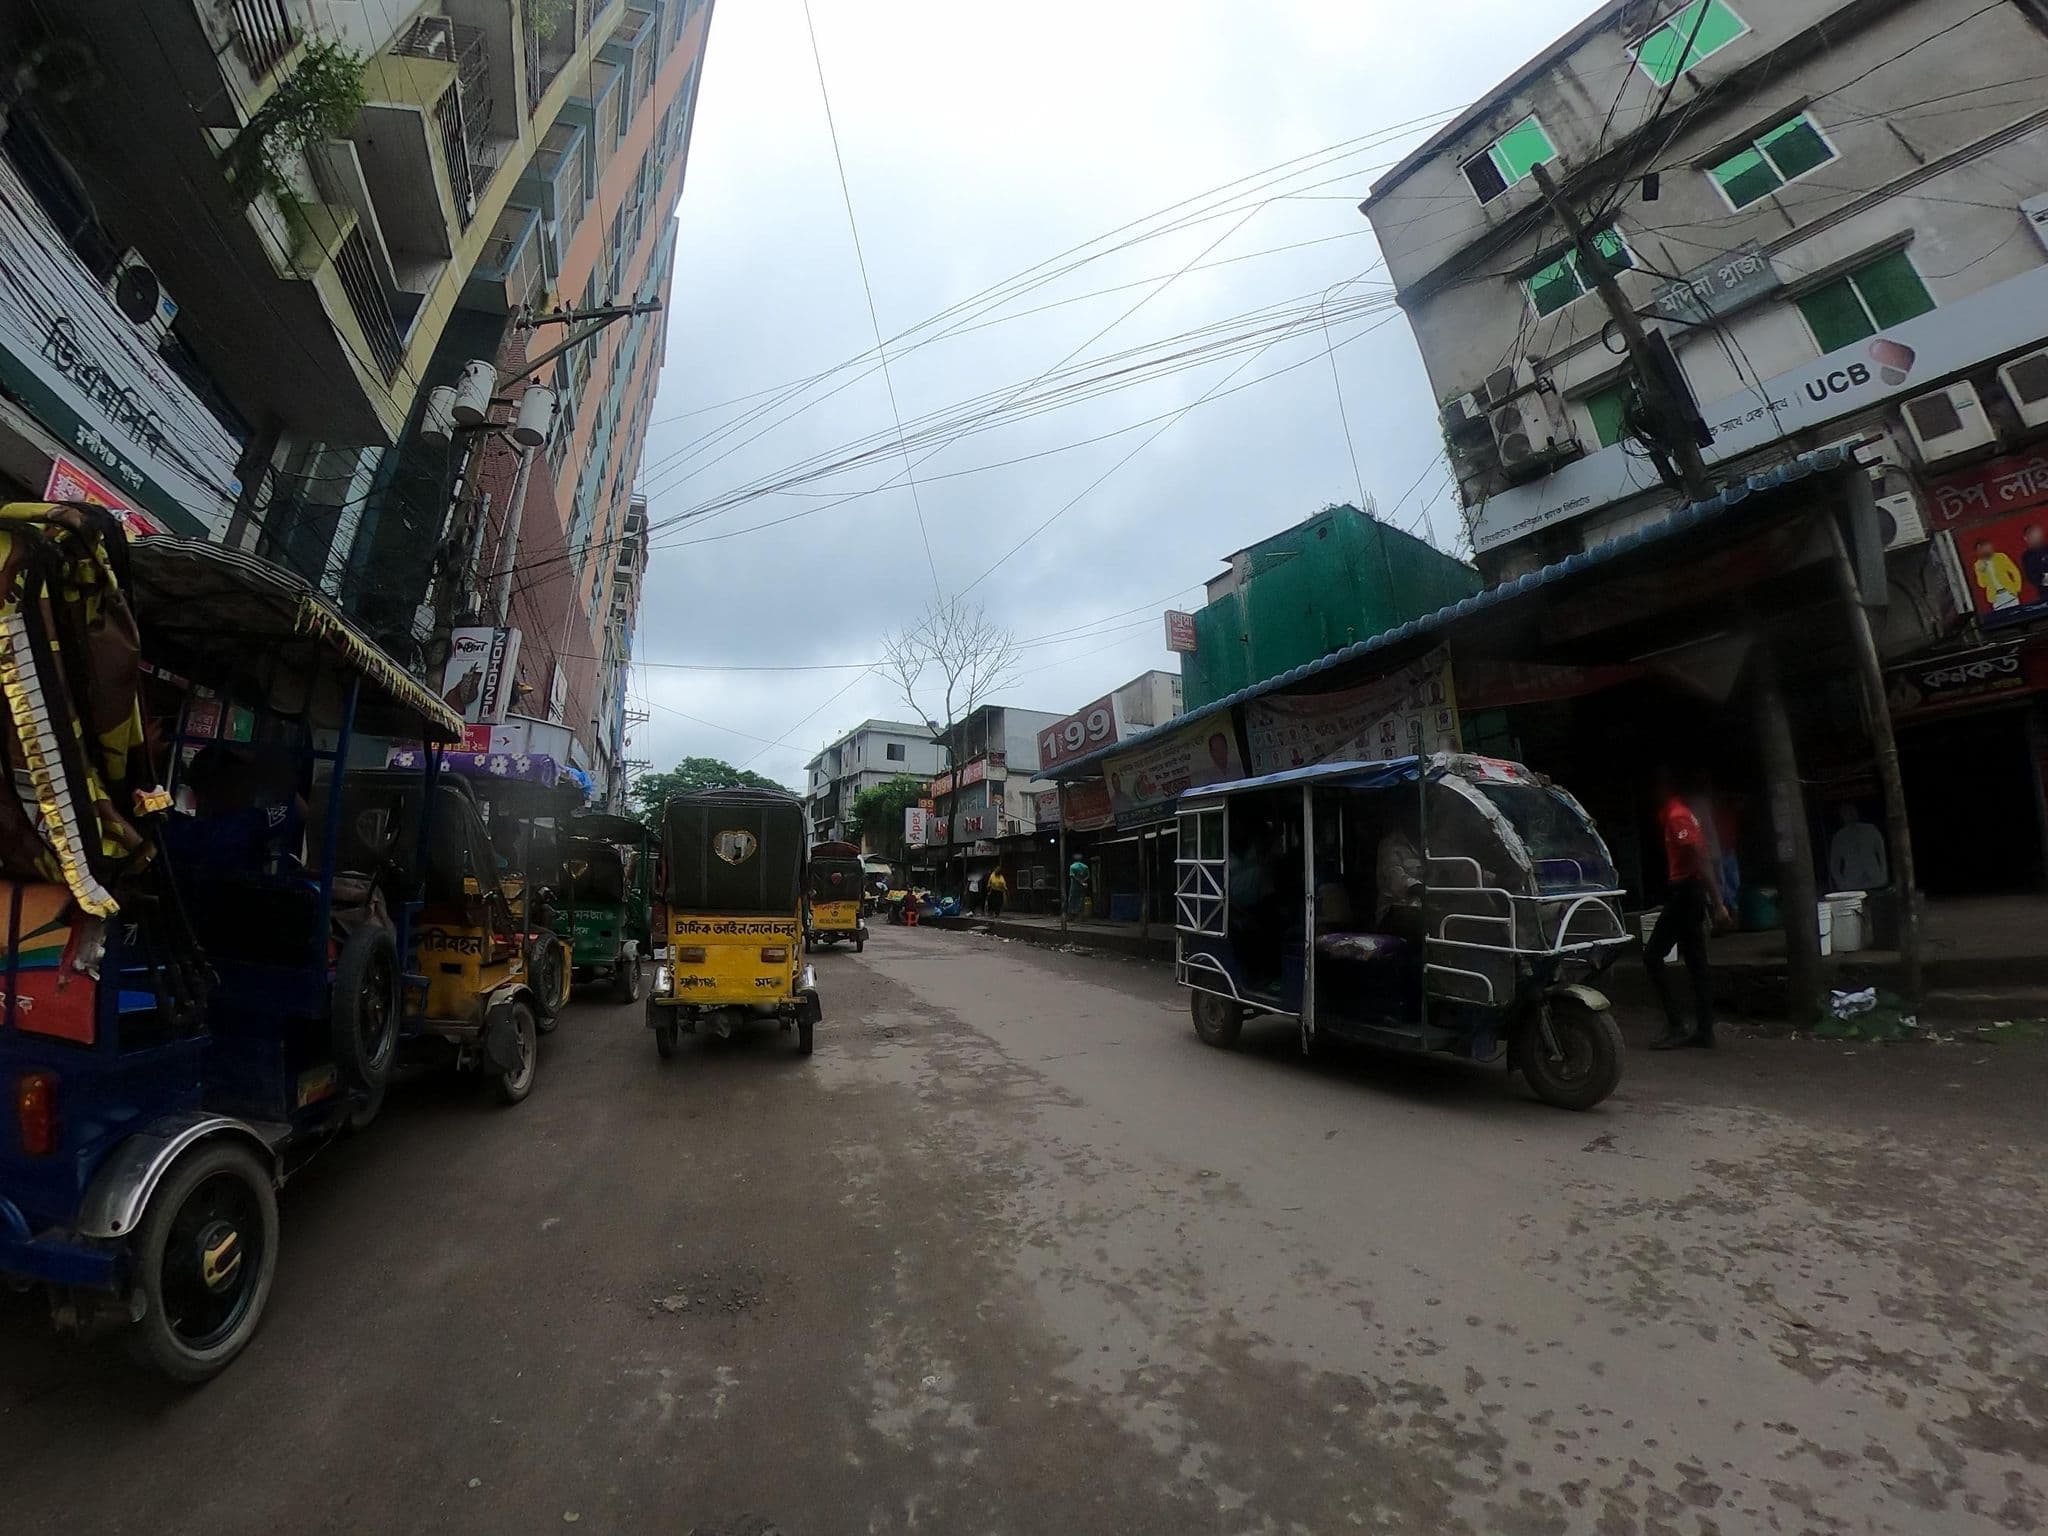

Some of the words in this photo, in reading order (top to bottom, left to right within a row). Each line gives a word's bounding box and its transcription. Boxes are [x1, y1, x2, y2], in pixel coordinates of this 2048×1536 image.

[1806, 362, 1871, 404] UCB
[1920, 646, 2019, 688] কনকর্ড
[909, 811, 923, 841] Apex
[713, 921, 746, 935] আইন
